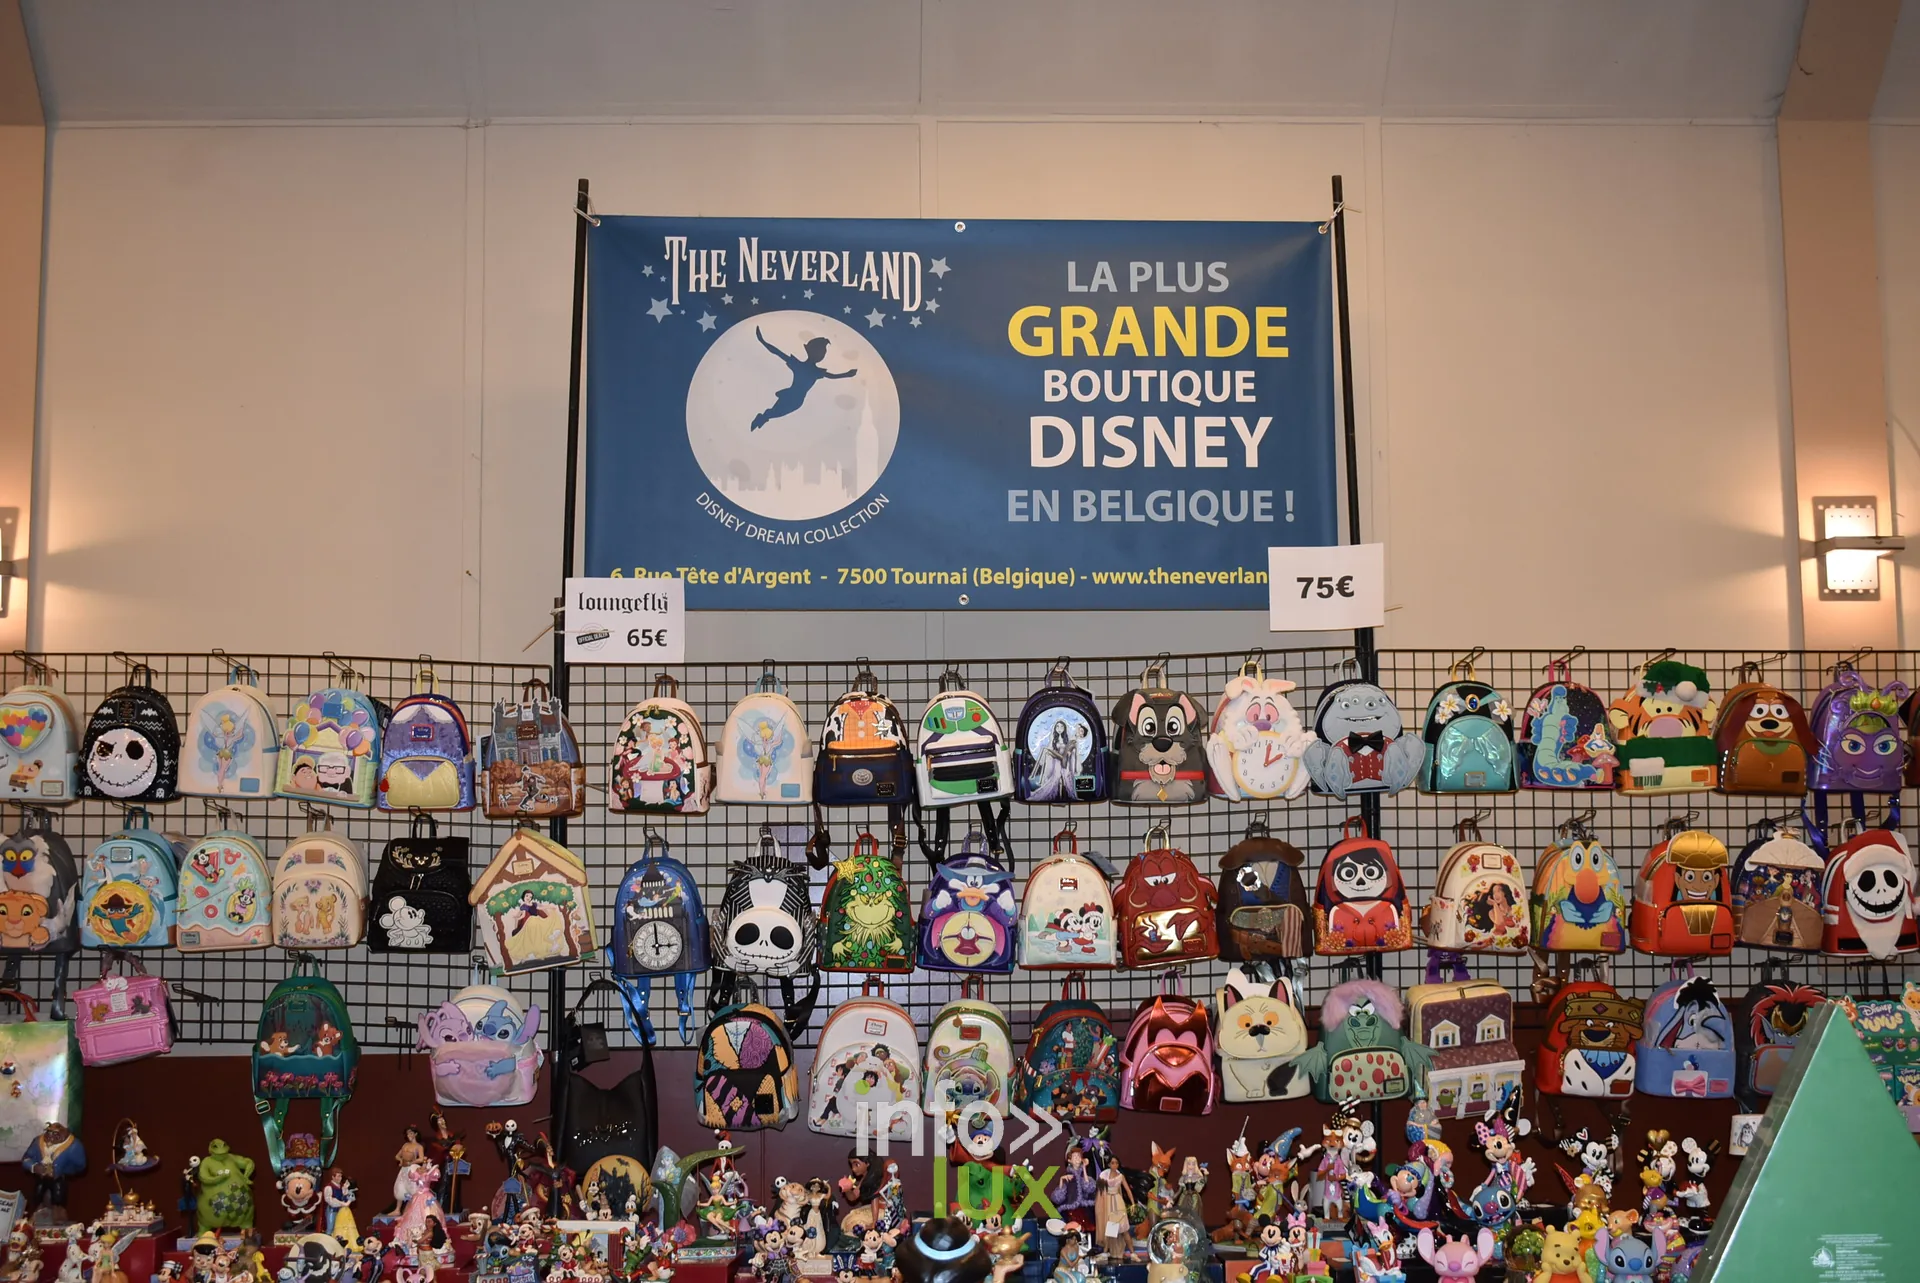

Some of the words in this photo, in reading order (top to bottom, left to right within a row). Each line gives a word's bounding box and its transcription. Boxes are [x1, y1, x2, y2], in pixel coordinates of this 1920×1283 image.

[1068, 261, 1117, 293] LA
[1129, 261, 1229, 294] PLUS
[1007, 305, 1289, 358] GRANDE
[1044, 369, 1256, 407] BOUTIQUE
[1030, 416, 1273, 468] DISNEY
[696, 492, 746, 532] DISNEY
[745, 524, 800, 545] DREAM
[803, 493, 890, 544] COLLECTION
[1008, 490, 1060, 522] EN
[1073, 490, 1274, 527] BELGIQUE
[1284, 490, 1295, 522] !
[676, 566, 720, 584] Tête
[724, 566, 811, 589] d'Argent
[837, 568, 887, 585] 7500
[891, 567, 967, 585] Tournai
[973, 567, 1075, 589] (Belgique)
[1296, 575, 1355, 599] 75€
[578, 592, 668, 614] loungefly
[627, 629, 667, 647] 65€
[1858, 1003, 1892, 1016] Disney
